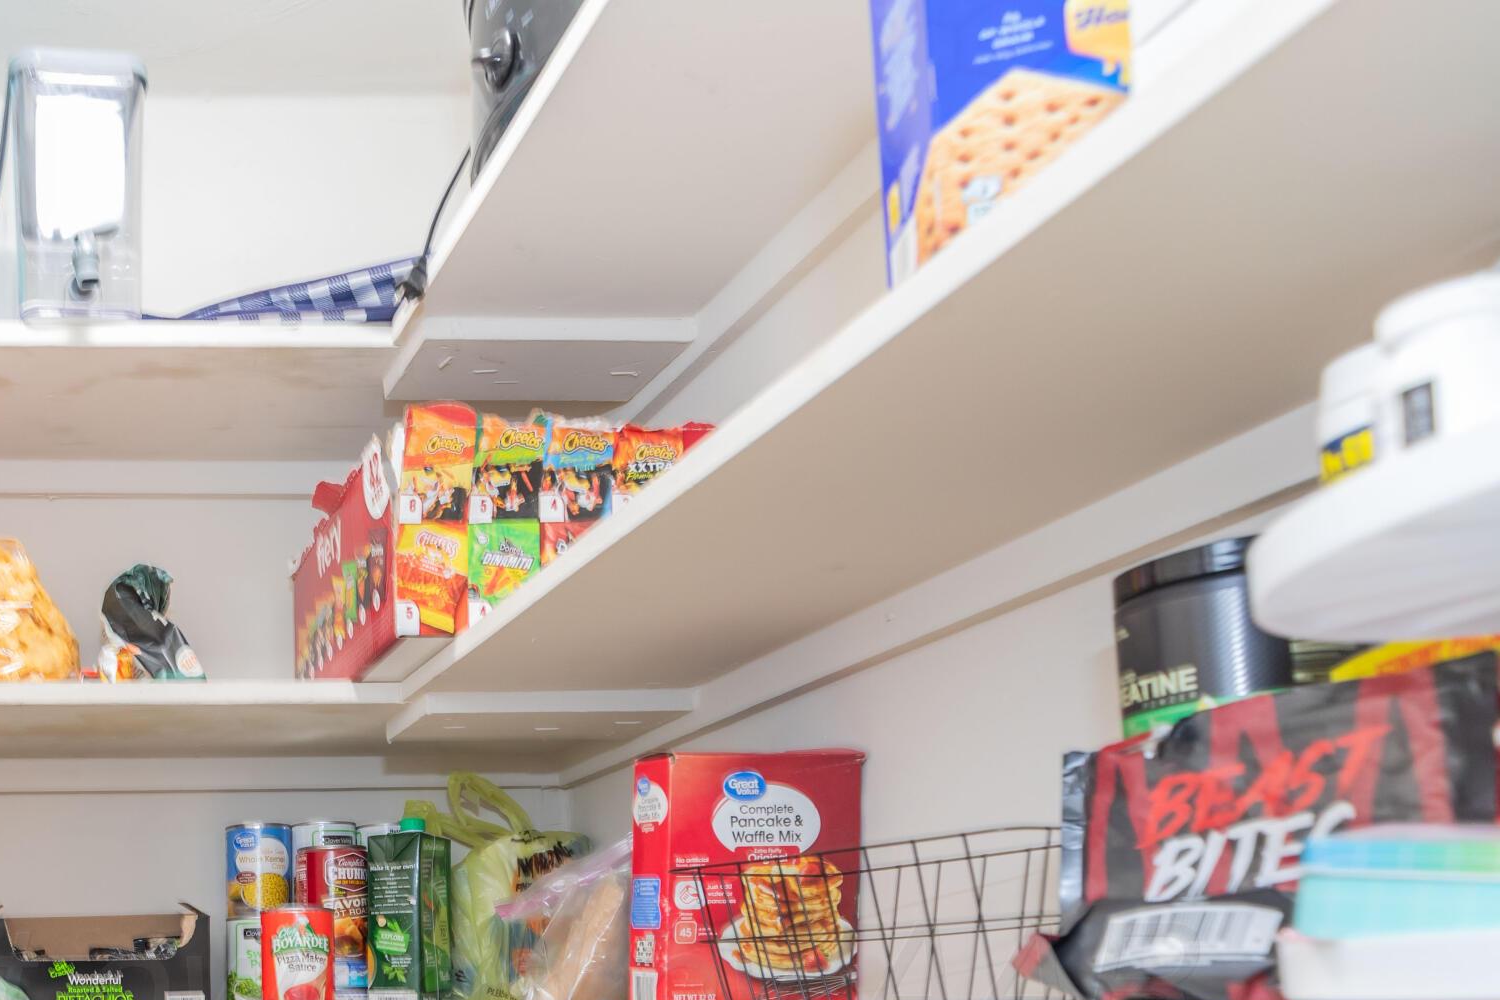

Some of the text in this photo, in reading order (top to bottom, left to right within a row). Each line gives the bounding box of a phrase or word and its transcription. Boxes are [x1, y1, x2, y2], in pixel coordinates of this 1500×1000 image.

[427, 436, 465, 454] Cheetos
[500, 430, 543, 449] Cheetos
[564, 432, 608, 453] Cheetos
[635, 444, 677, 461] Cheetos
[627, 460, 674, 473] XXTRA
[482, 552, 534, 571] DINAMITA
[728, 778, 759, 790] Great
[1137, 724, 1394, 850] BEAST
[736, 786, 760, 796] Value
[739, 804, 794, 815] Complete
[730, 815, 803, 828] Pancake &
[732, 830, 802, 844] Waffle Mix
[686, 856, 709, 864] artificial
[747, 852, 789, 865] Original
[329, 867, 368, 880] CHUNK
[391, 865, 402, 873] your
[679, 928, 692, 938] 45
[274, 934, 328, 953] BOYARDEE
[277, 954, 300, 966] Pizza
[288, 963, 316, 973] Sauce
[67, 973, 122, 985] Wonderful
[673, 993, 686, 1000] NET
[687, 993, 698, 1000] WT
